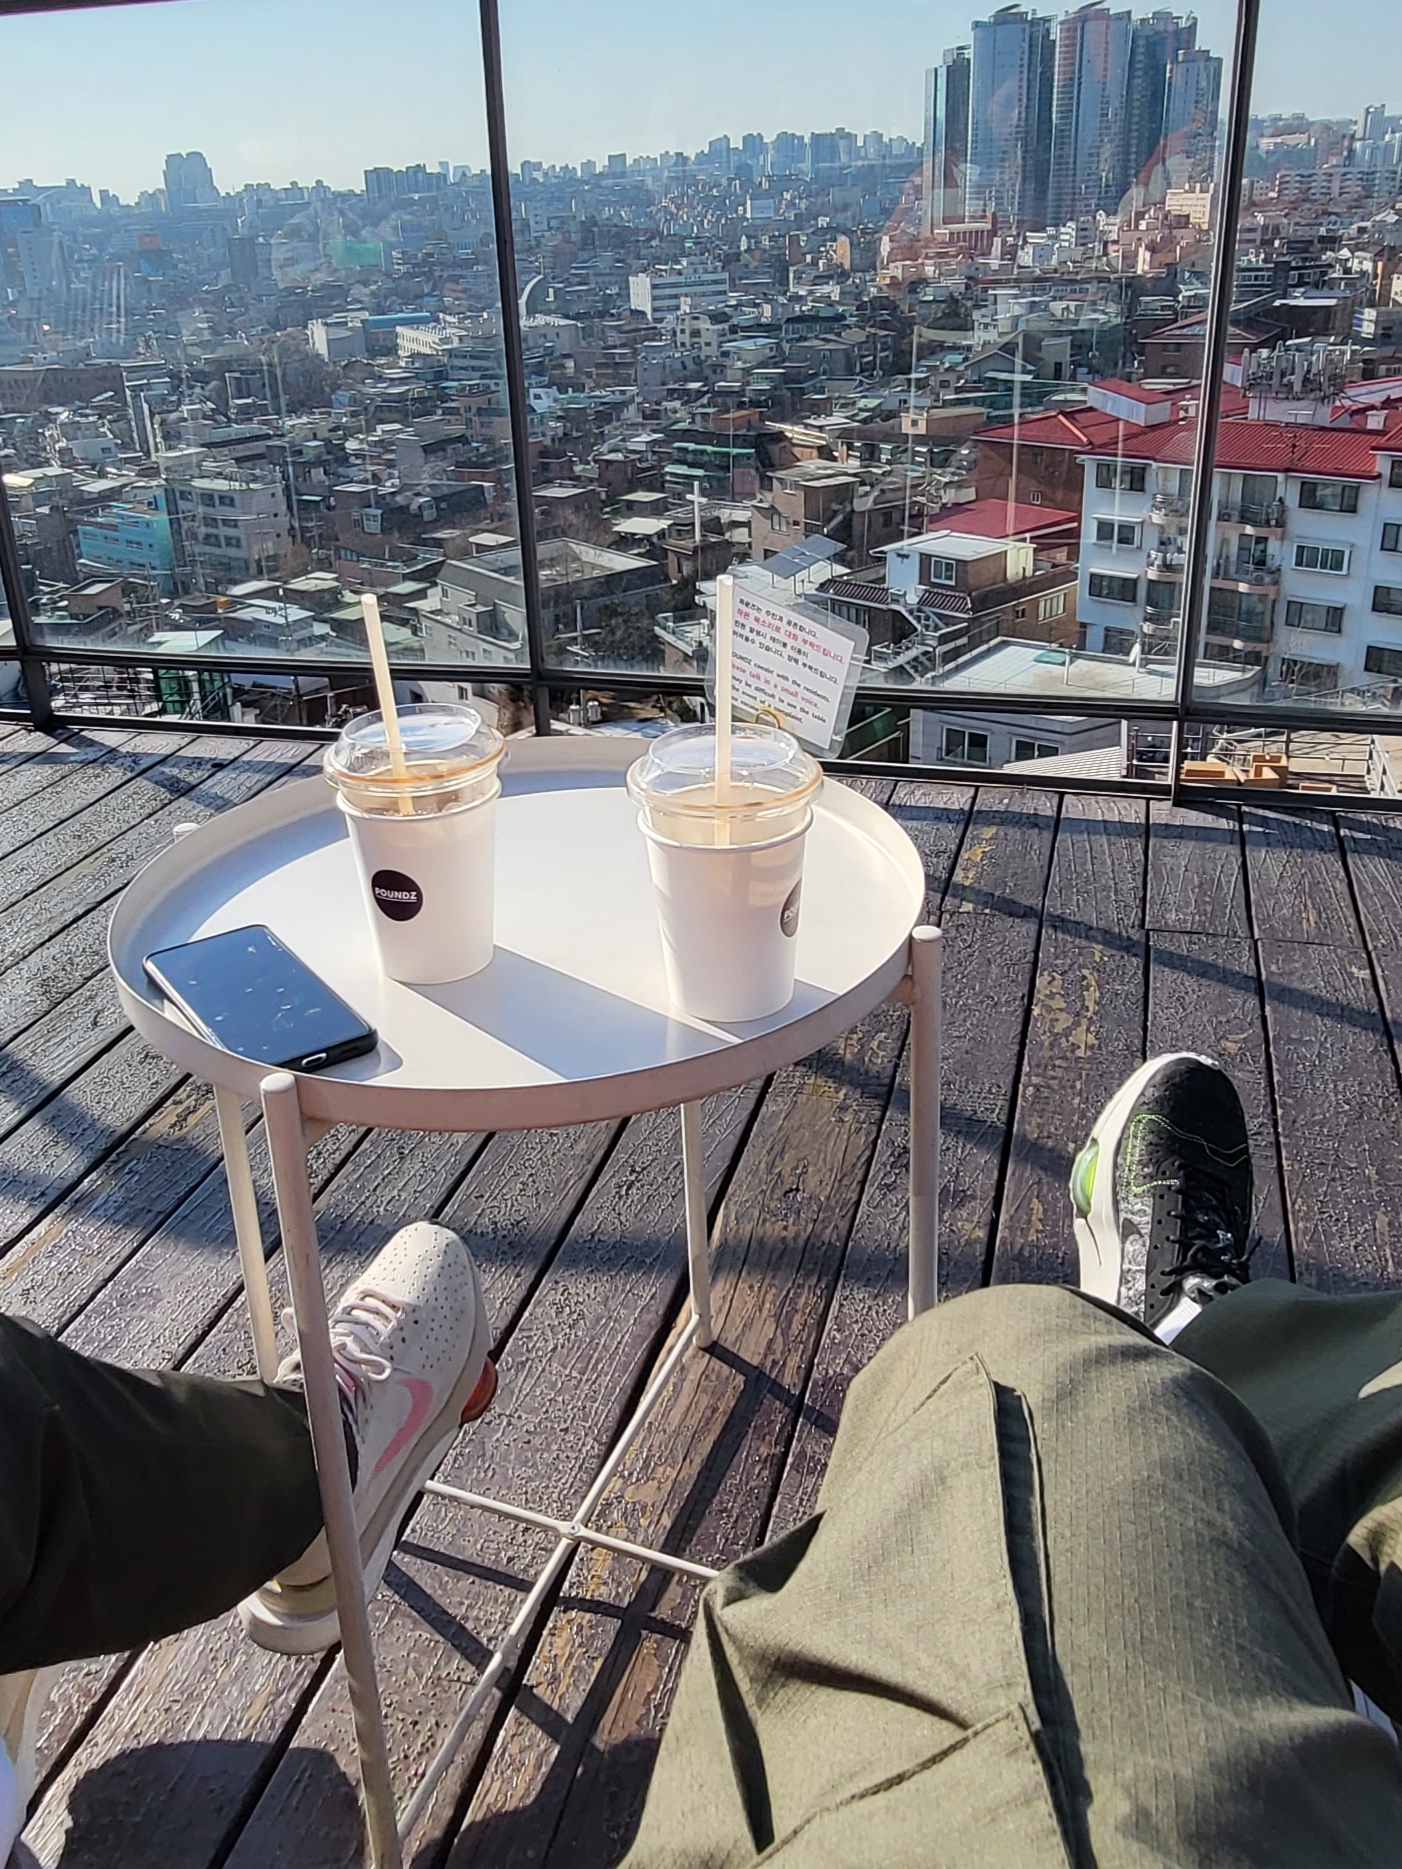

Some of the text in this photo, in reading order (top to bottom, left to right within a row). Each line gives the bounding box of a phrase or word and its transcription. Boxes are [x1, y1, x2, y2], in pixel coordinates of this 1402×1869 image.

[737, 609, 750, 620] 작은
[754, 616, 781, 633] 목소리로
[785, 630, 798, 641] 대화
[750, 670, 761, 680] talk
[764, 677, 771, 685] in
[781, 686, 799, 698] small
[777, 673, 789, 682] with
[792, 680, 801, 688] the
[755, 686, 776, 699] difficult
[800, 707, 809, 715] the
[812, 713, 827, 723] table
[759, 698, 766, 706] of
[375, 887, 417, 899] POUNDZ
